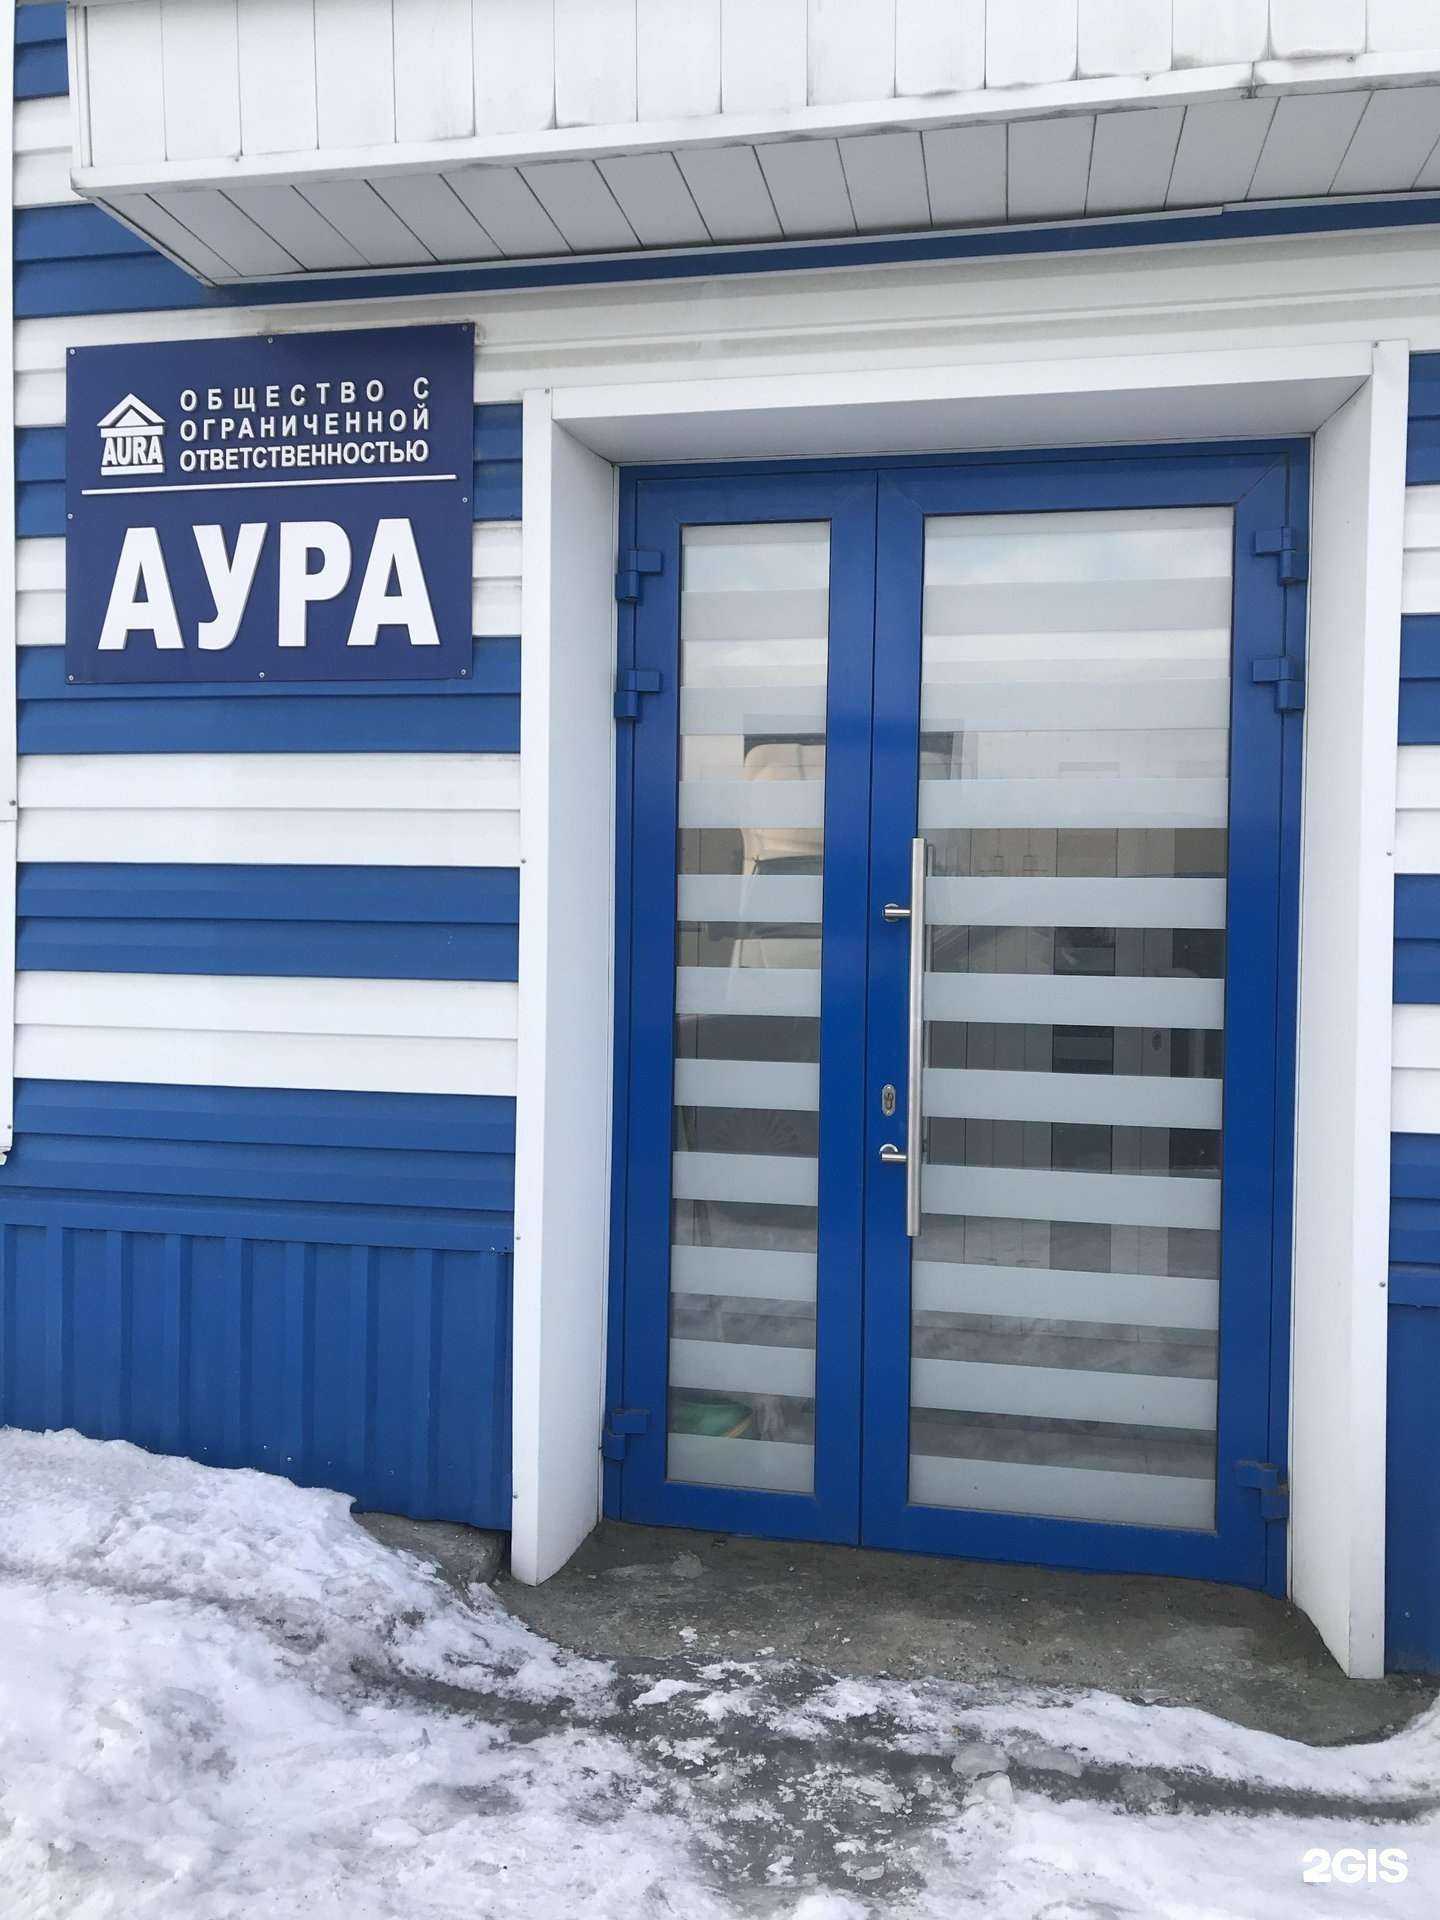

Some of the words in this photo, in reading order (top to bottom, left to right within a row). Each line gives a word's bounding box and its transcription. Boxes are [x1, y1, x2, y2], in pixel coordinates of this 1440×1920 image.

[180, 379, 385, 413] ОБЩЕСТВО
[412, 376, 431, 400] С
[180, 404, 431, 443] ОГРАНИЧЕННОЙ
[101, 436, 164, 466] AURA
[180, 439, 430, 473] ОТВЕТСТВЕННОСТЬЮ
[97, 518, 441, 651] АУРА
